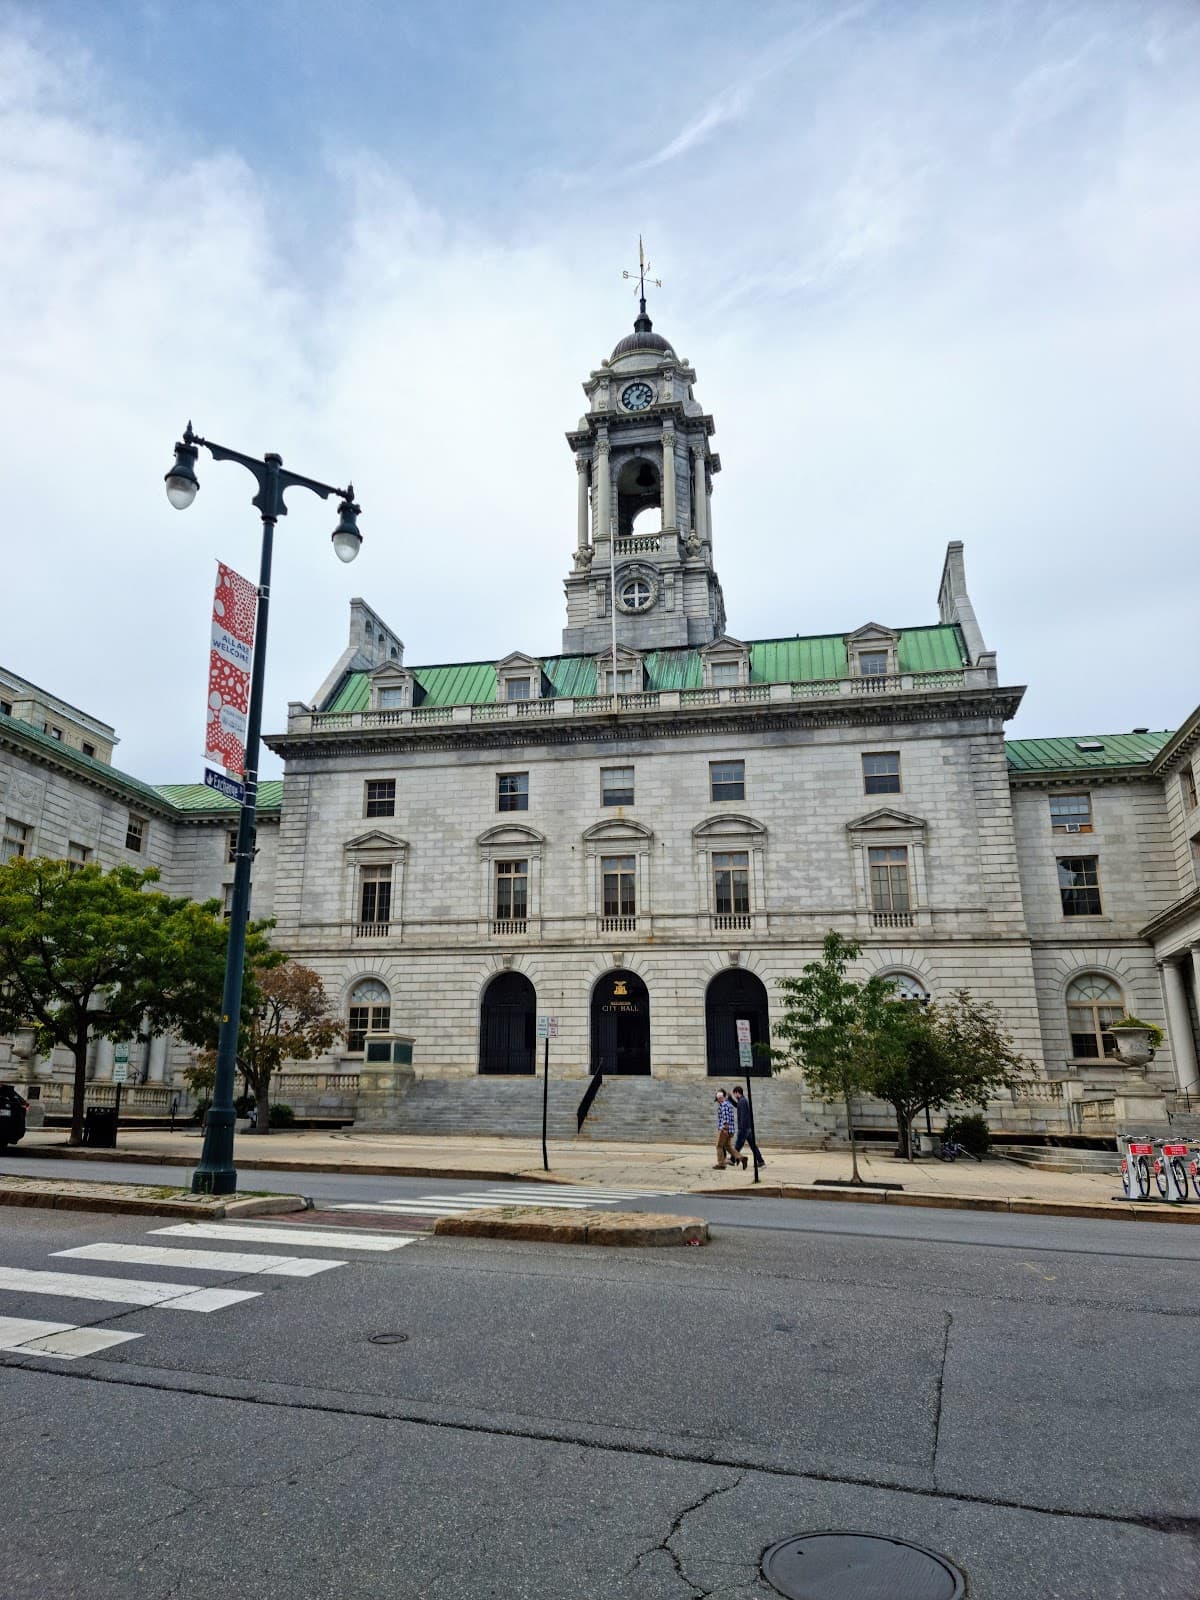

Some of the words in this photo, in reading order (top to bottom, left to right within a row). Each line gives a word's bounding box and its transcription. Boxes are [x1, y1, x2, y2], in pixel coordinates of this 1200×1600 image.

[222, 634, 236, 647] ALL
[213, 640, 249, 663] WELCOME
[213, 774, 238, 799] Exchange
[621, 1004, 640, 1012] HALL
